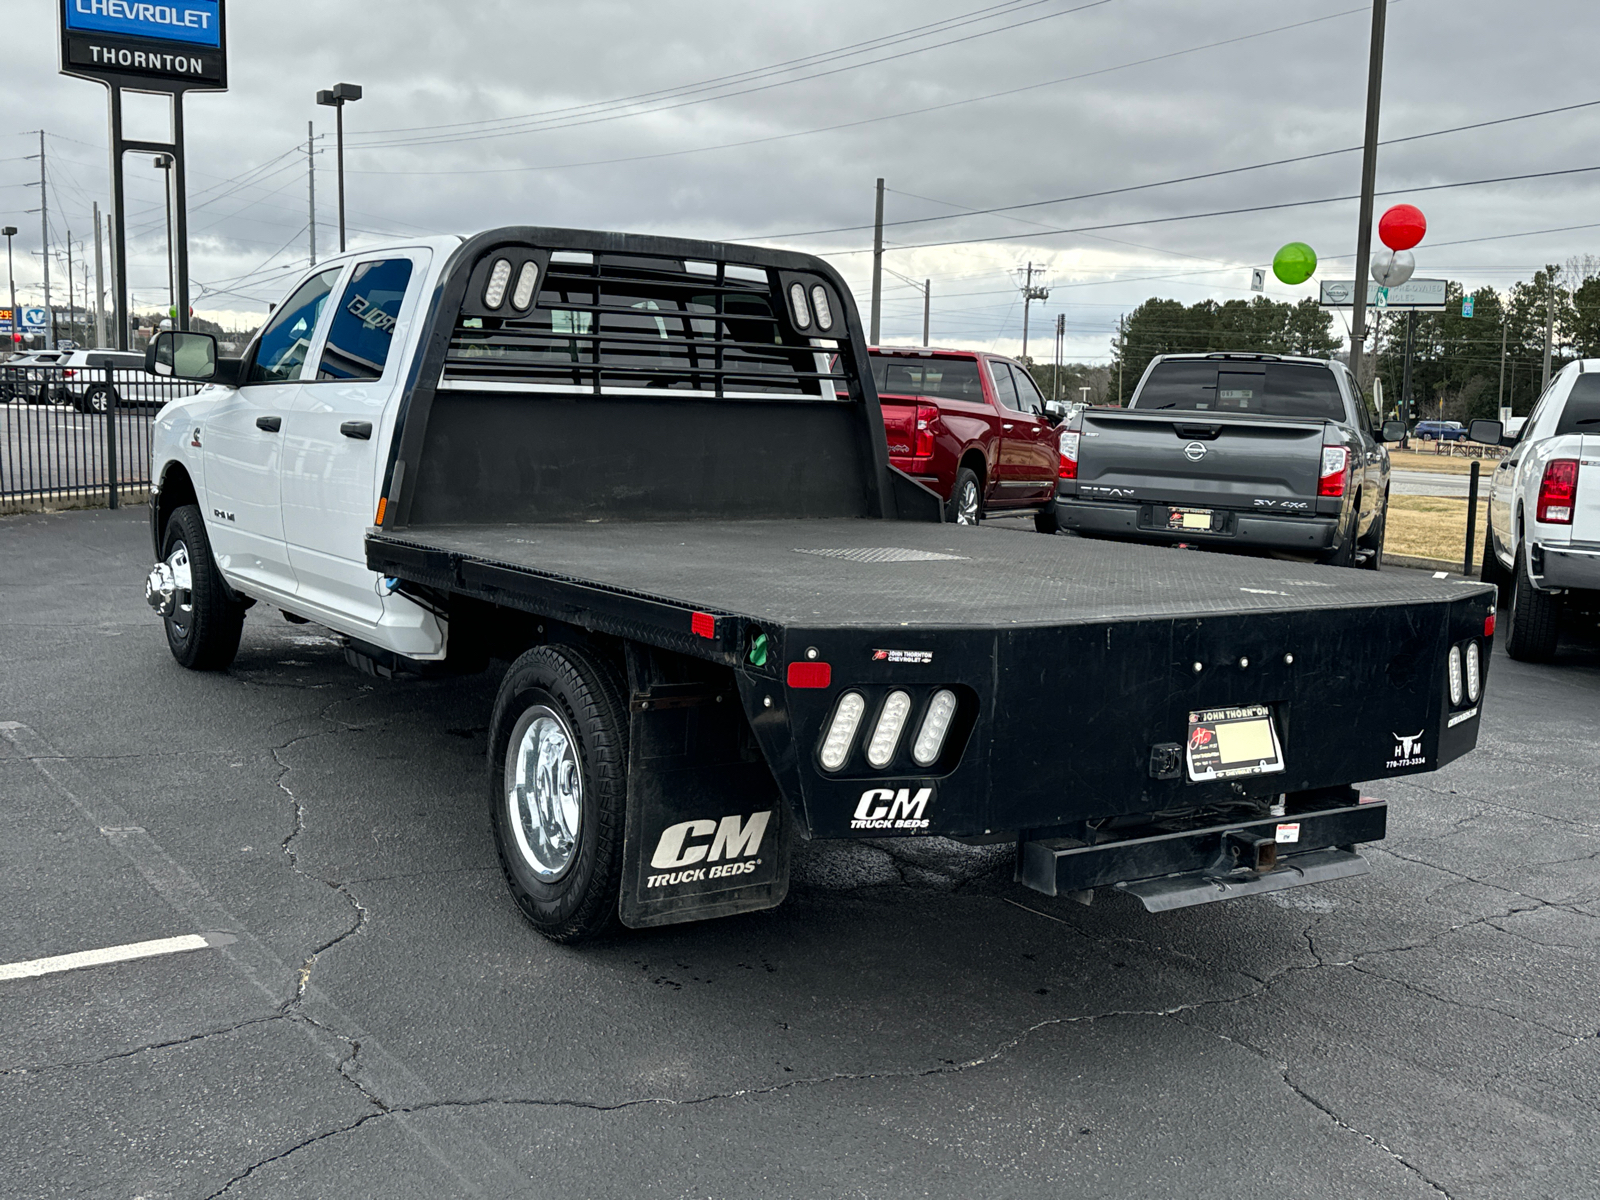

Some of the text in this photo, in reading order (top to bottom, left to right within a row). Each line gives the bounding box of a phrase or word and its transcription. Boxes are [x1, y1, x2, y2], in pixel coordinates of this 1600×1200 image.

[76, 0, 212, 29] CHEVROLET
[89, 45, 203, 74] THORNTON
[1393, 284, 1443, 293] PRE-OWNED
[1080, 485, 1135, 497] TITAN
[213, 508, 235, 521] RAM
[889, 650, 902, 658] JOHN
[904, 651, 933, 659] THORNTON
[1203, 710, 1225, 722] JOHN
[1394, 742, 1422, 758] H M
[1386, 757, 1426, 768] 770-773-3334
[853, 787, 932, 820] CM
[850, 819, 930, 829] TRUCK BEDS
[650, 810, 772, 869] CM
[646, 867, 707, 888] TRUCK
